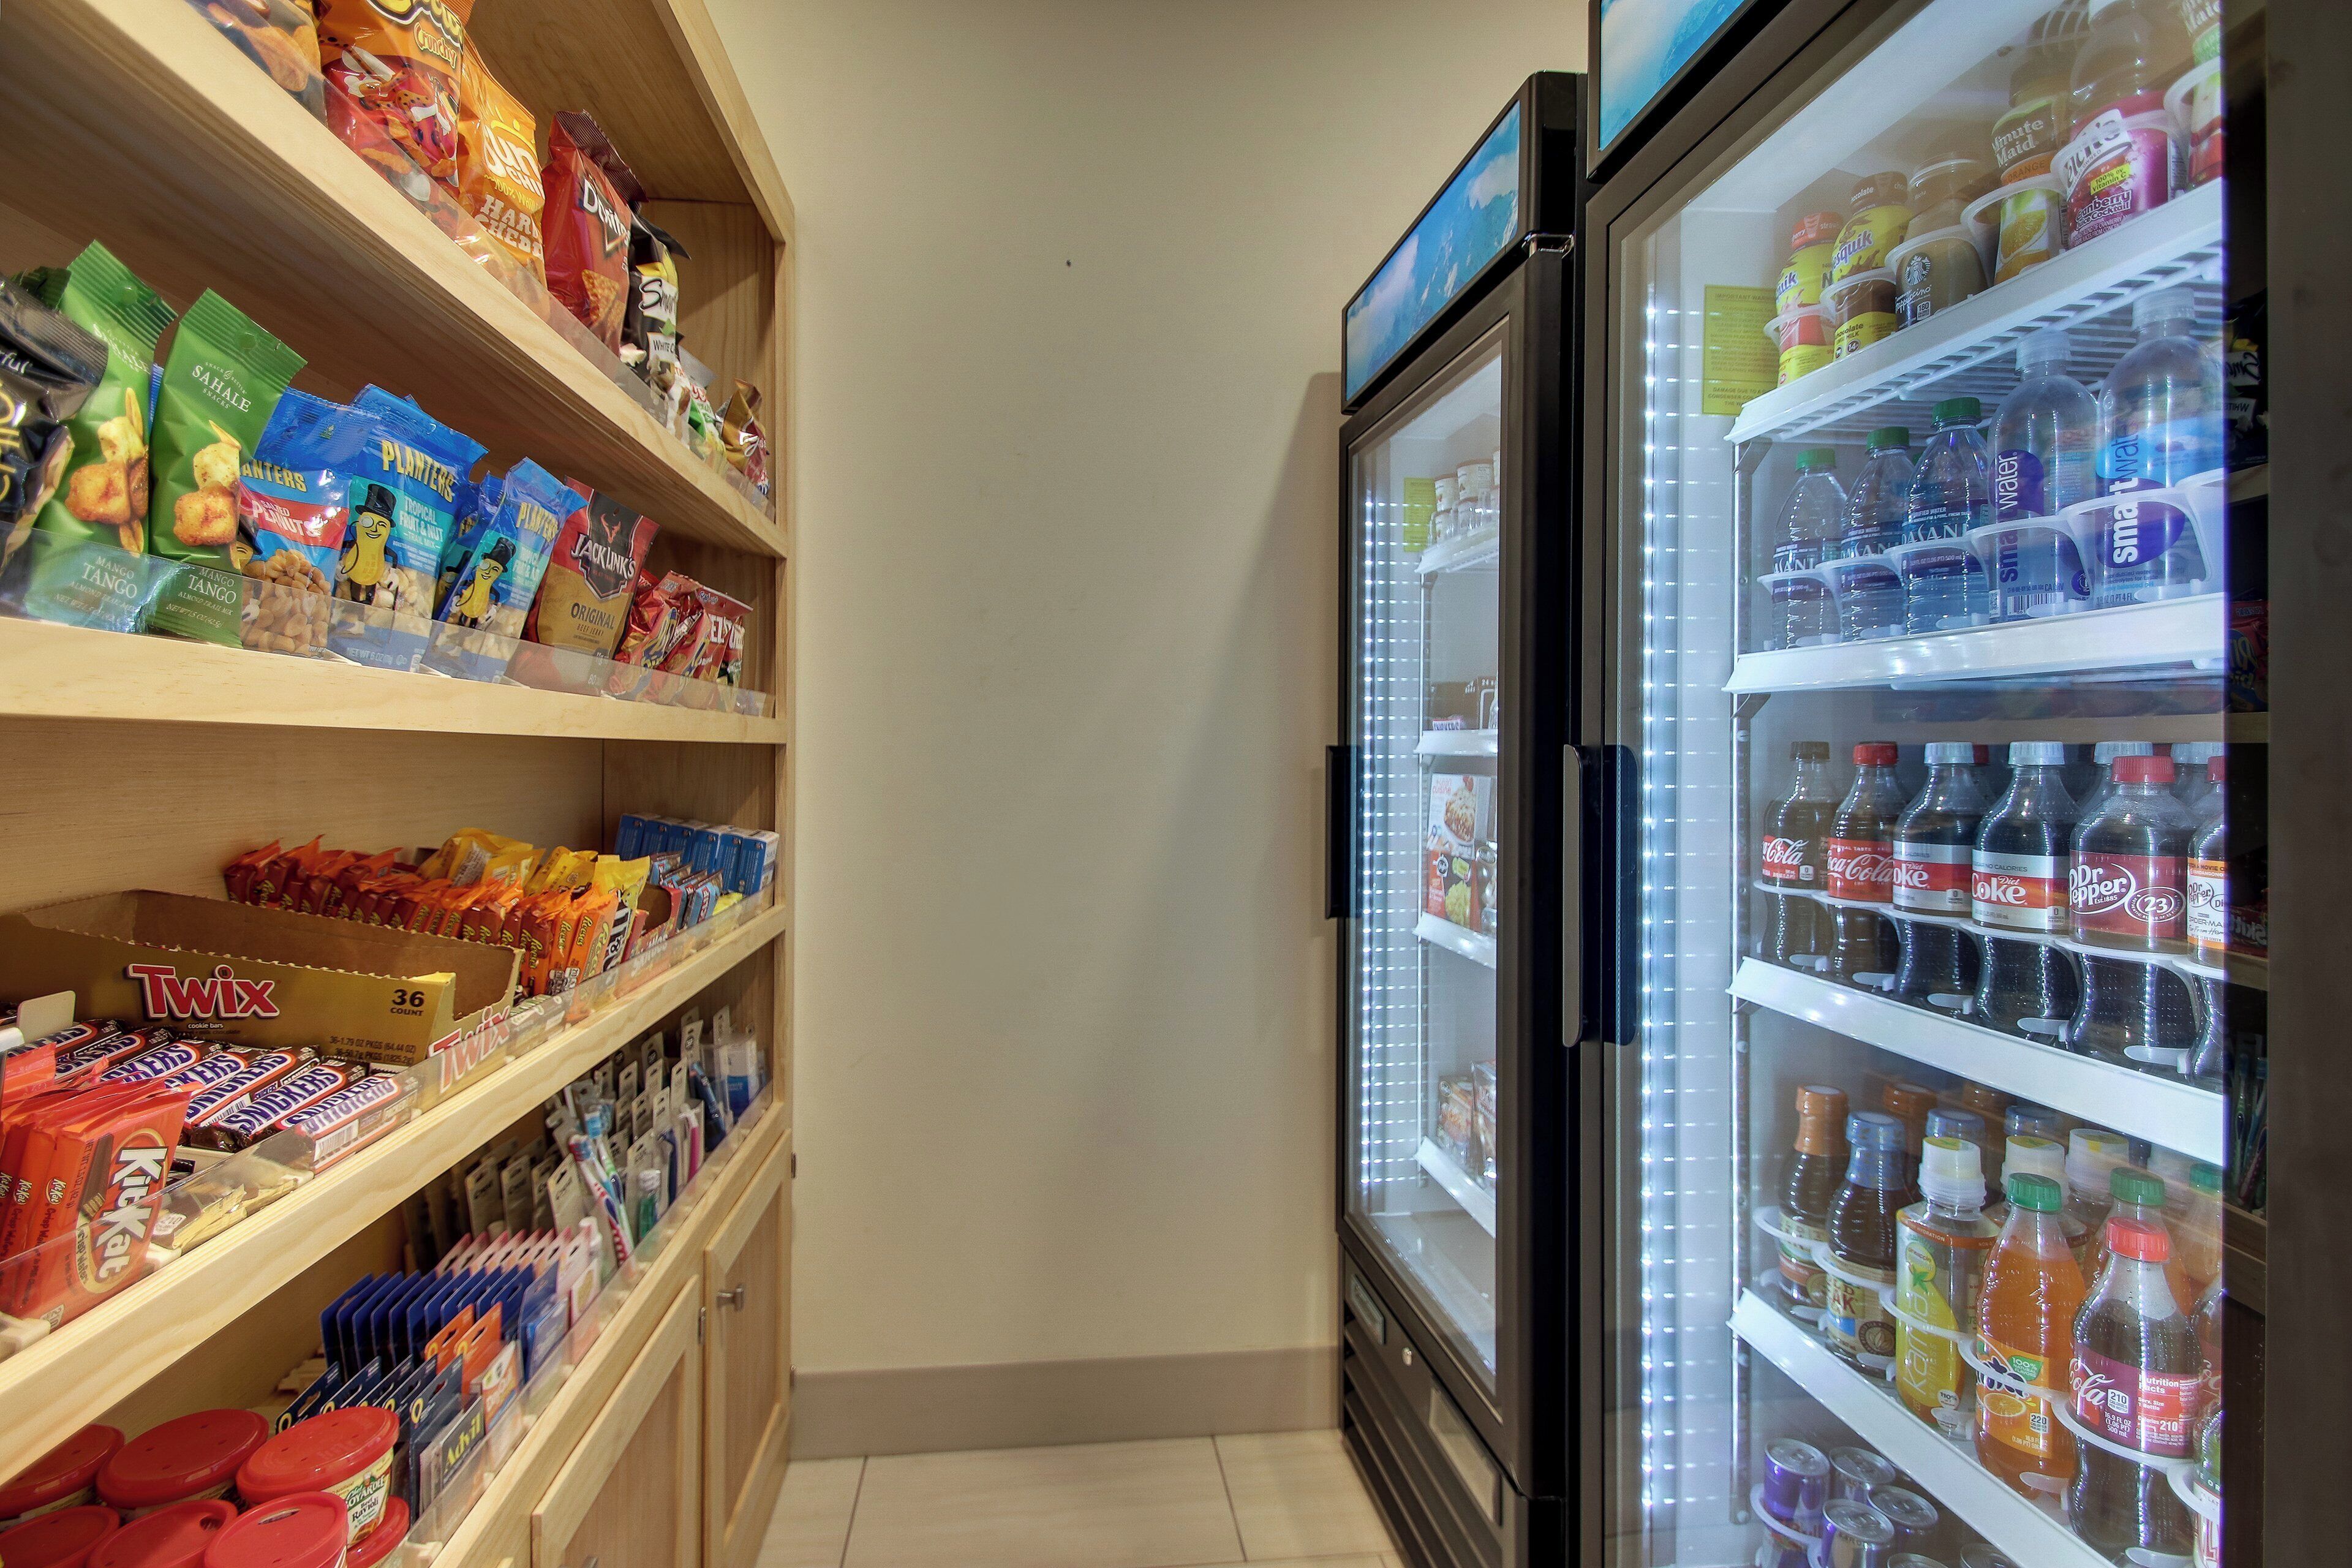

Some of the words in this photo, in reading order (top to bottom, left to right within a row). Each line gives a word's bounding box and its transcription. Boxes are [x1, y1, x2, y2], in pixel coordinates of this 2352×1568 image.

[413, 21, 457, 69] Crunchy
[1992, 119, 2044, 153] Minute
[482, 124, 543, 183] Sun
[1995, 134, 2038, 168] Maid
[2007, 160, 2046, 183] ORANGE
[2095, 172, 2114, 184] 100%
[2092, 176, 2119, 192] vitamin
[2090, 201, 2132, 222] Cocktail
[2098, 217, 2122, 228] CRANBERRY
[1918, 303, 1929, 311] 180
[653, 339, 670, 353] WHITE
[192, 365, 252, 413] SAHALE
[202, 388, 230, 409] SNACKS
[239, 459, 307, 492] ANTERS
[381, 439, 456, 503] PLANTERS
[251, 499, 322, 538] PEANUT
[260, 499, 290, 517] SALTED
[404, 496, 437, 524] TROPICAL
[399, 511, 420, 532] FRUIT
[420, 521, 427, 535] &
[427, 525, 443, 542] NUT
[2109, 477, 2138, 565] smat
[571, 531, 606, 570] JACK
[606, 546, 636, 580] LINK'S
[96, 555, 135, 579] MANGO
[199, 567, 235, 587] MANGO
[81, 562, 137, 598] TANGO
[187, 575, 237, 604] TANGO
[166, 603, 181, 612] NET
[178, 591, 203, 603] ALMOND
[202, 599, 221, 612] TRAIL
[222, 606, 233, 616] MIX
[570, 602, 616, 630] ORIGINAL
[576, 623, 589, 633] BEEF
[1893, 864, 1929, 888] oke
[1994, 864, 2028, 873] CALORIES
[2075, 864, 2104, 884] Dr
[1972, 872, 2027, 905] Coke
[1997, 875, 2021, 886] Diet
[2069, 867, 2127, 908] Pepper
[2094, 895, 2118, 905] Est.1885
[2143, 895, 2168, 913] 23
[2194, 925, 2207, 934] From
[127, 963, 280, 1020] Twix
[391, 989, 425, 1008] 36
[390, 1007, 424, 1017] COUNT
[365, 1039, 383, 1050] PKGS
[224, 1068, 341, 1133] SNICKERS
[81, 1153, 90, 1165] WT
[15, 1178, 32, 1205] KitKat
[49, 1178, 67, 1205] KitKat
[39, 1207, 56, 1230] Crisp
[95, 1145, 168, 1281] KitKat
[1918, 1226, 1945, 1242] HYDRATION
[2012, 1357, 2038, 1371] 100%
[2013, 1363, 2037, 1374] NATURAL
[2110, 1392, 2127, 1404] 210
[2031, 1414, 2048, 1425] 220
[2105, 1410, 2116, 1421] 16.9
[2124, 1419, 2132, 1427] OZ
[2105, 1418, 2120, 1430] (1.06
[2120, 1423, 2130, 1432] PT)
[2160, 1420, 2179, 1432] 210
[447, 1415, 482, 1465] Advil
[2107, 1426, 2118, 1434] 500
[2119, 1430, 2128, 1438] mL
[348, 1476, 385, 1507] OYARDEE
[352, 1497, 379, 1523] Ravioli
